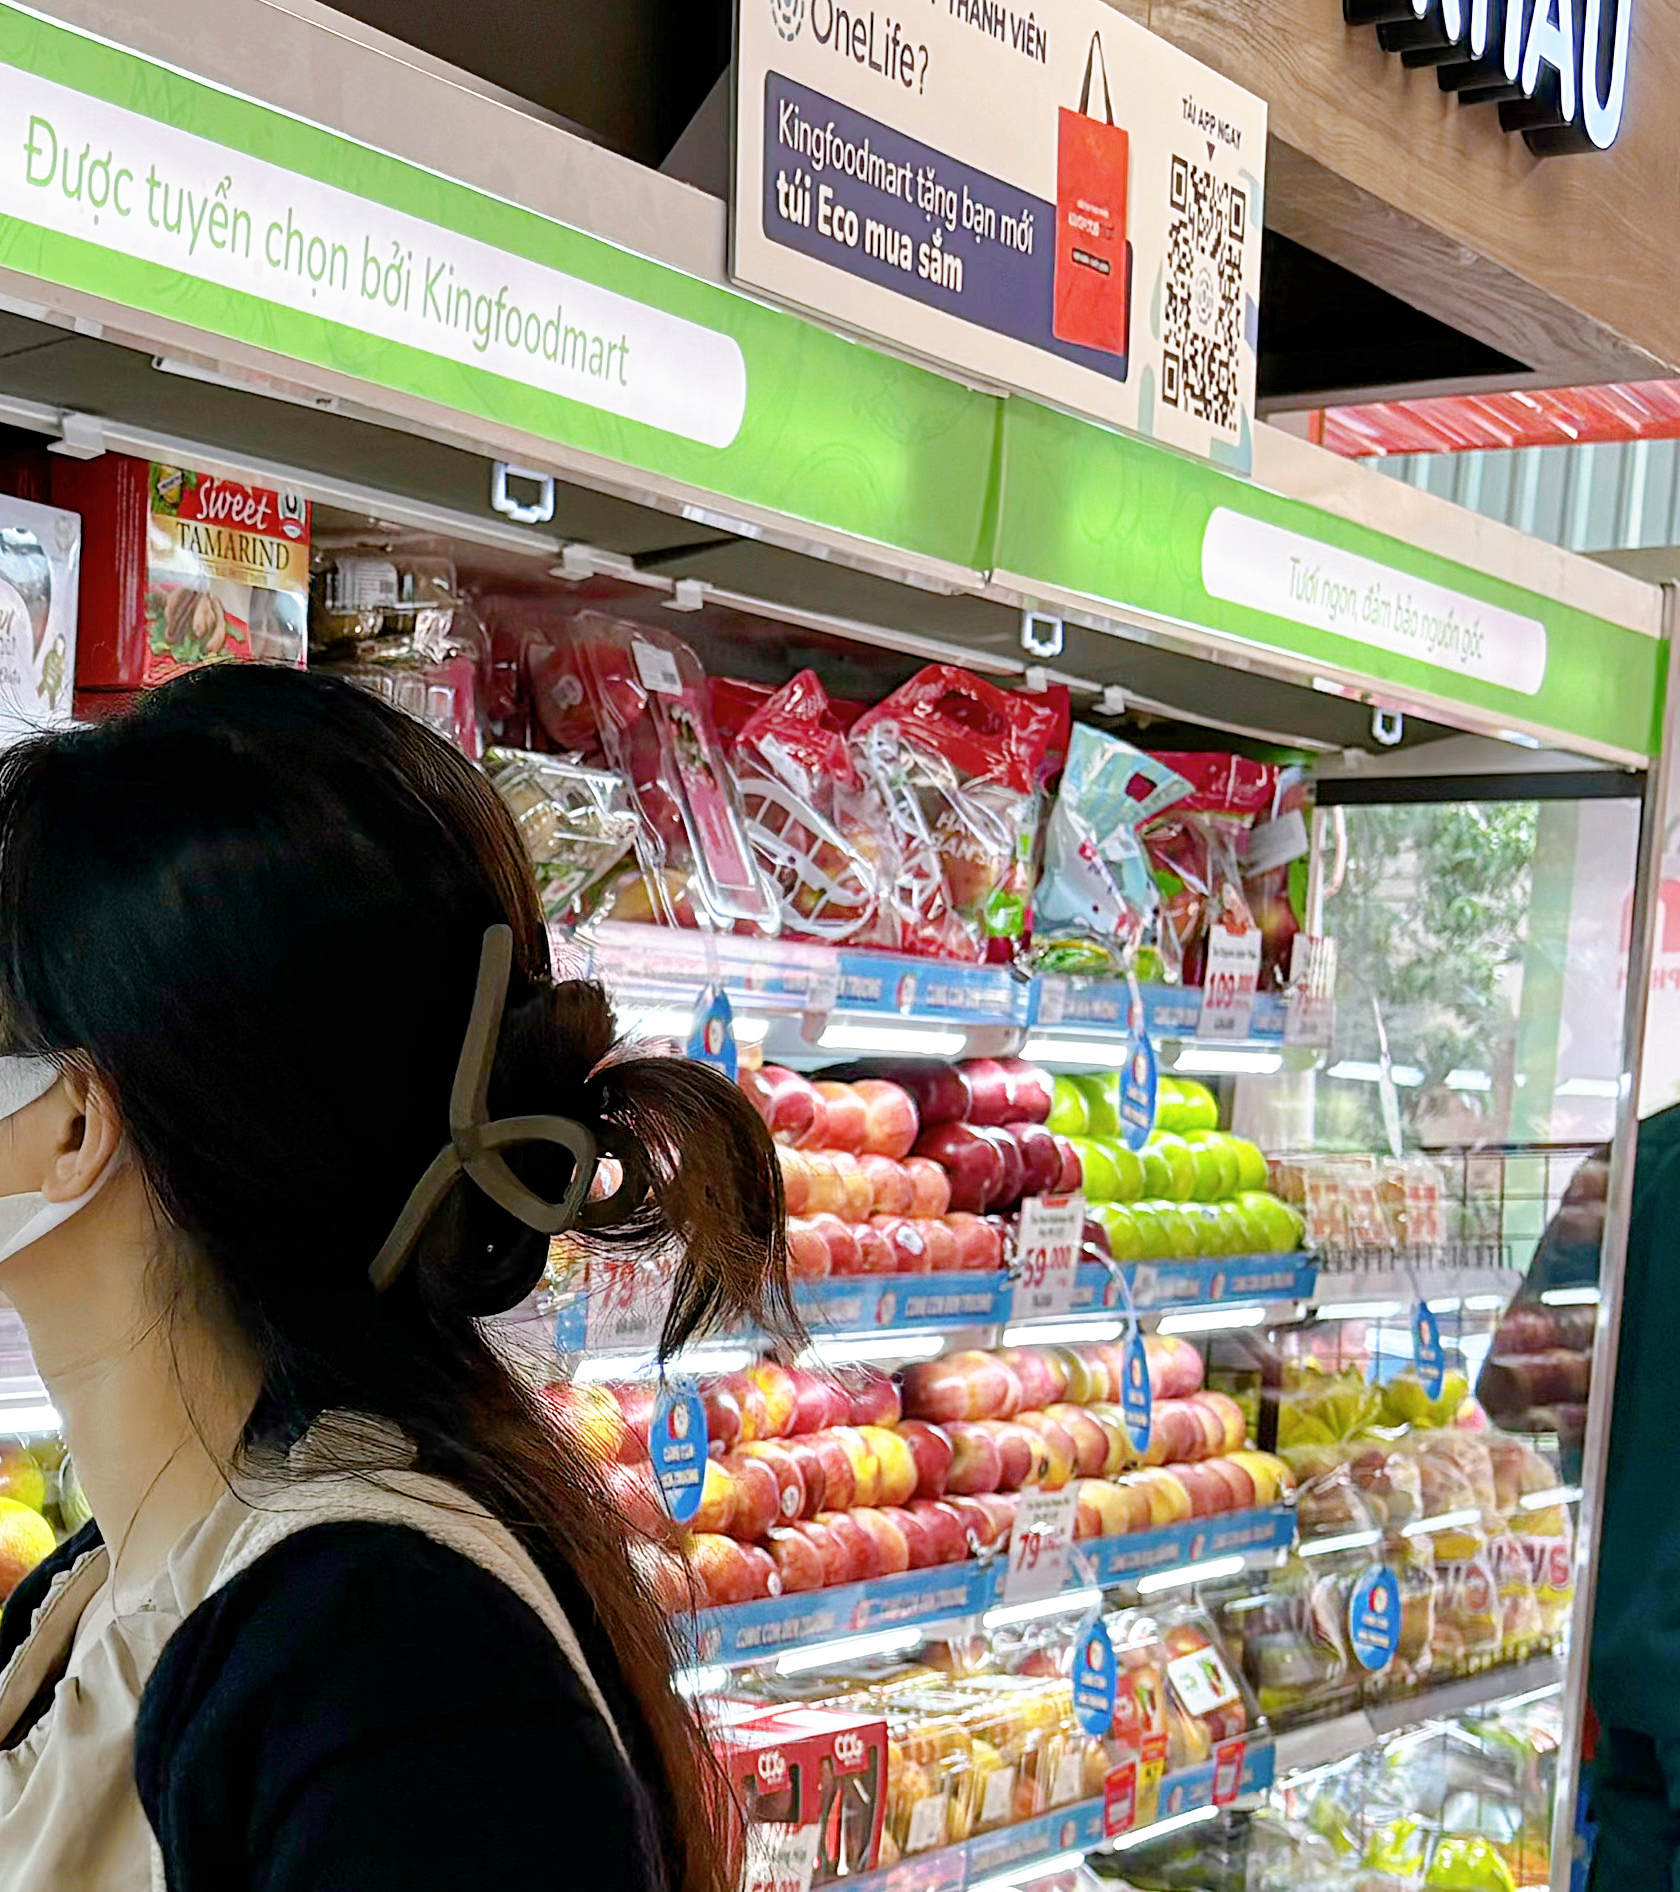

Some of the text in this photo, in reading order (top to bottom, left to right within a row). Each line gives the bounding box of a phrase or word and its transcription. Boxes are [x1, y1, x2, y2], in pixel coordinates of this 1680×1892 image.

[1009, 16, 1046, 64] VIÊN
[1198, 111, 1215, 136] APP
[778, 99, 1033, 255] Kingfoodmart tặng bạn mới
[23, 115, 629, 387] Được tuyển chọn bởi Kingfoodmart
[776, 168, 963, 292] túi Eco mua sắm
[196, 477, 272, 531] Sweet
[176, 520, 290, 572] TAMARIND
